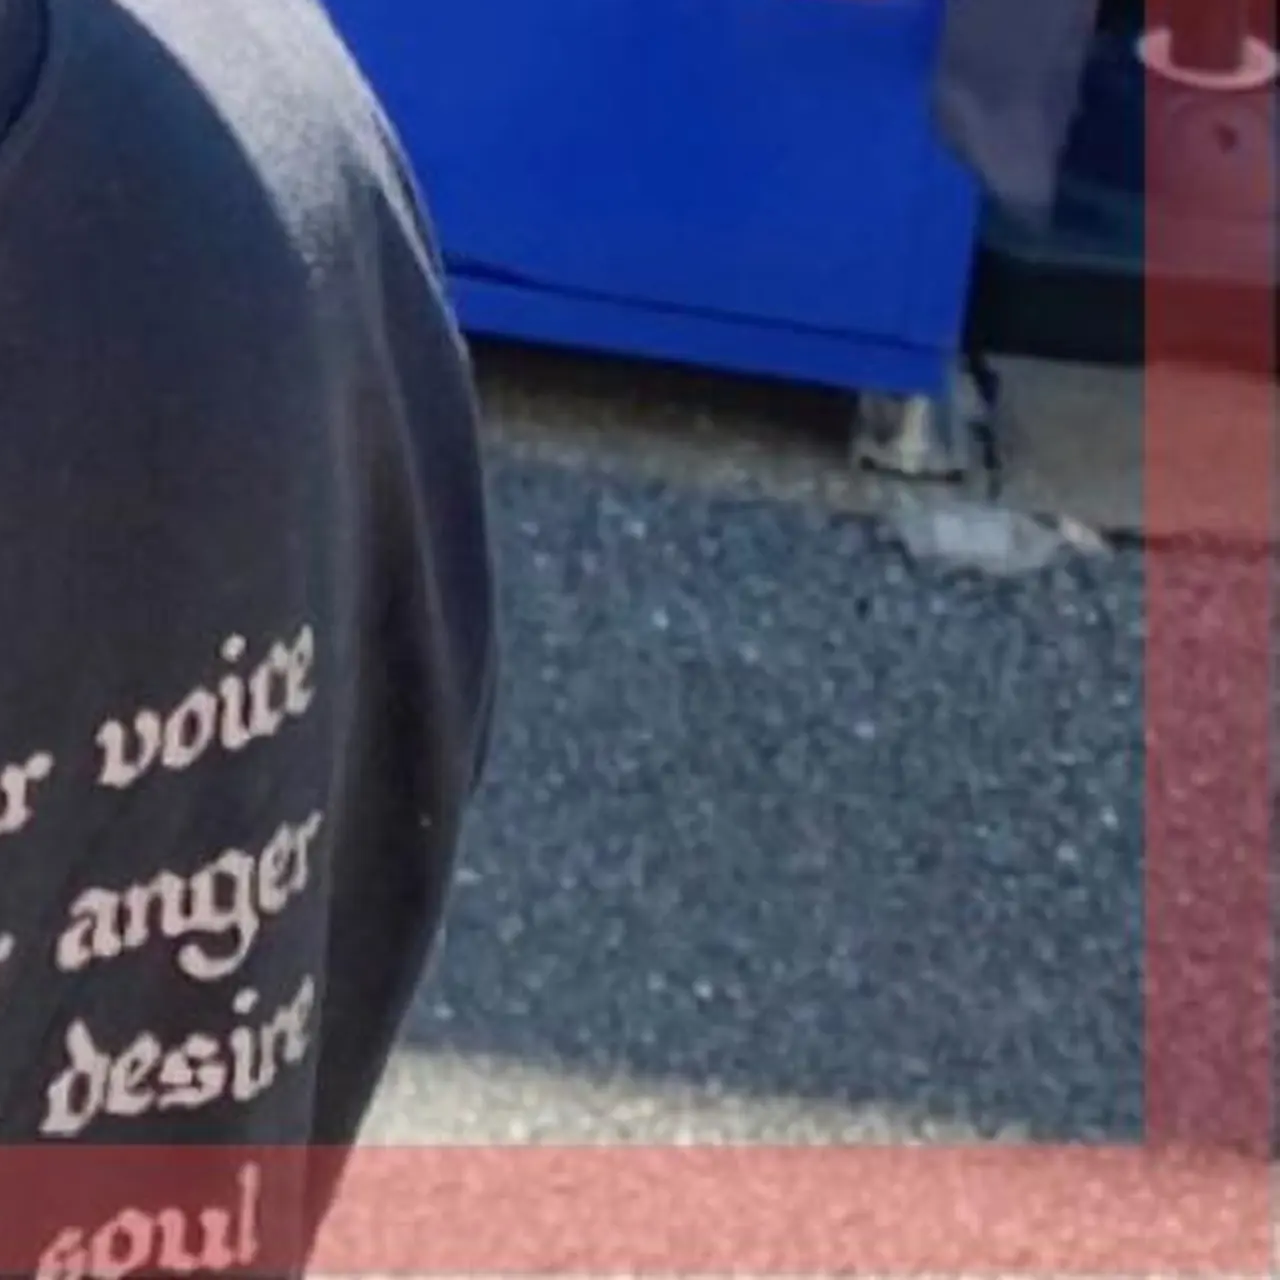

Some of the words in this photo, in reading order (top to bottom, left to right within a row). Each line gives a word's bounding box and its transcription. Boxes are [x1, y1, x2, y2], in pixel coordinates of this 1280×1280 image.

[94, 623, 316, 790] voice
[54, 811, 324, 982] anger
[34, 1162, 261, 1280] soul
